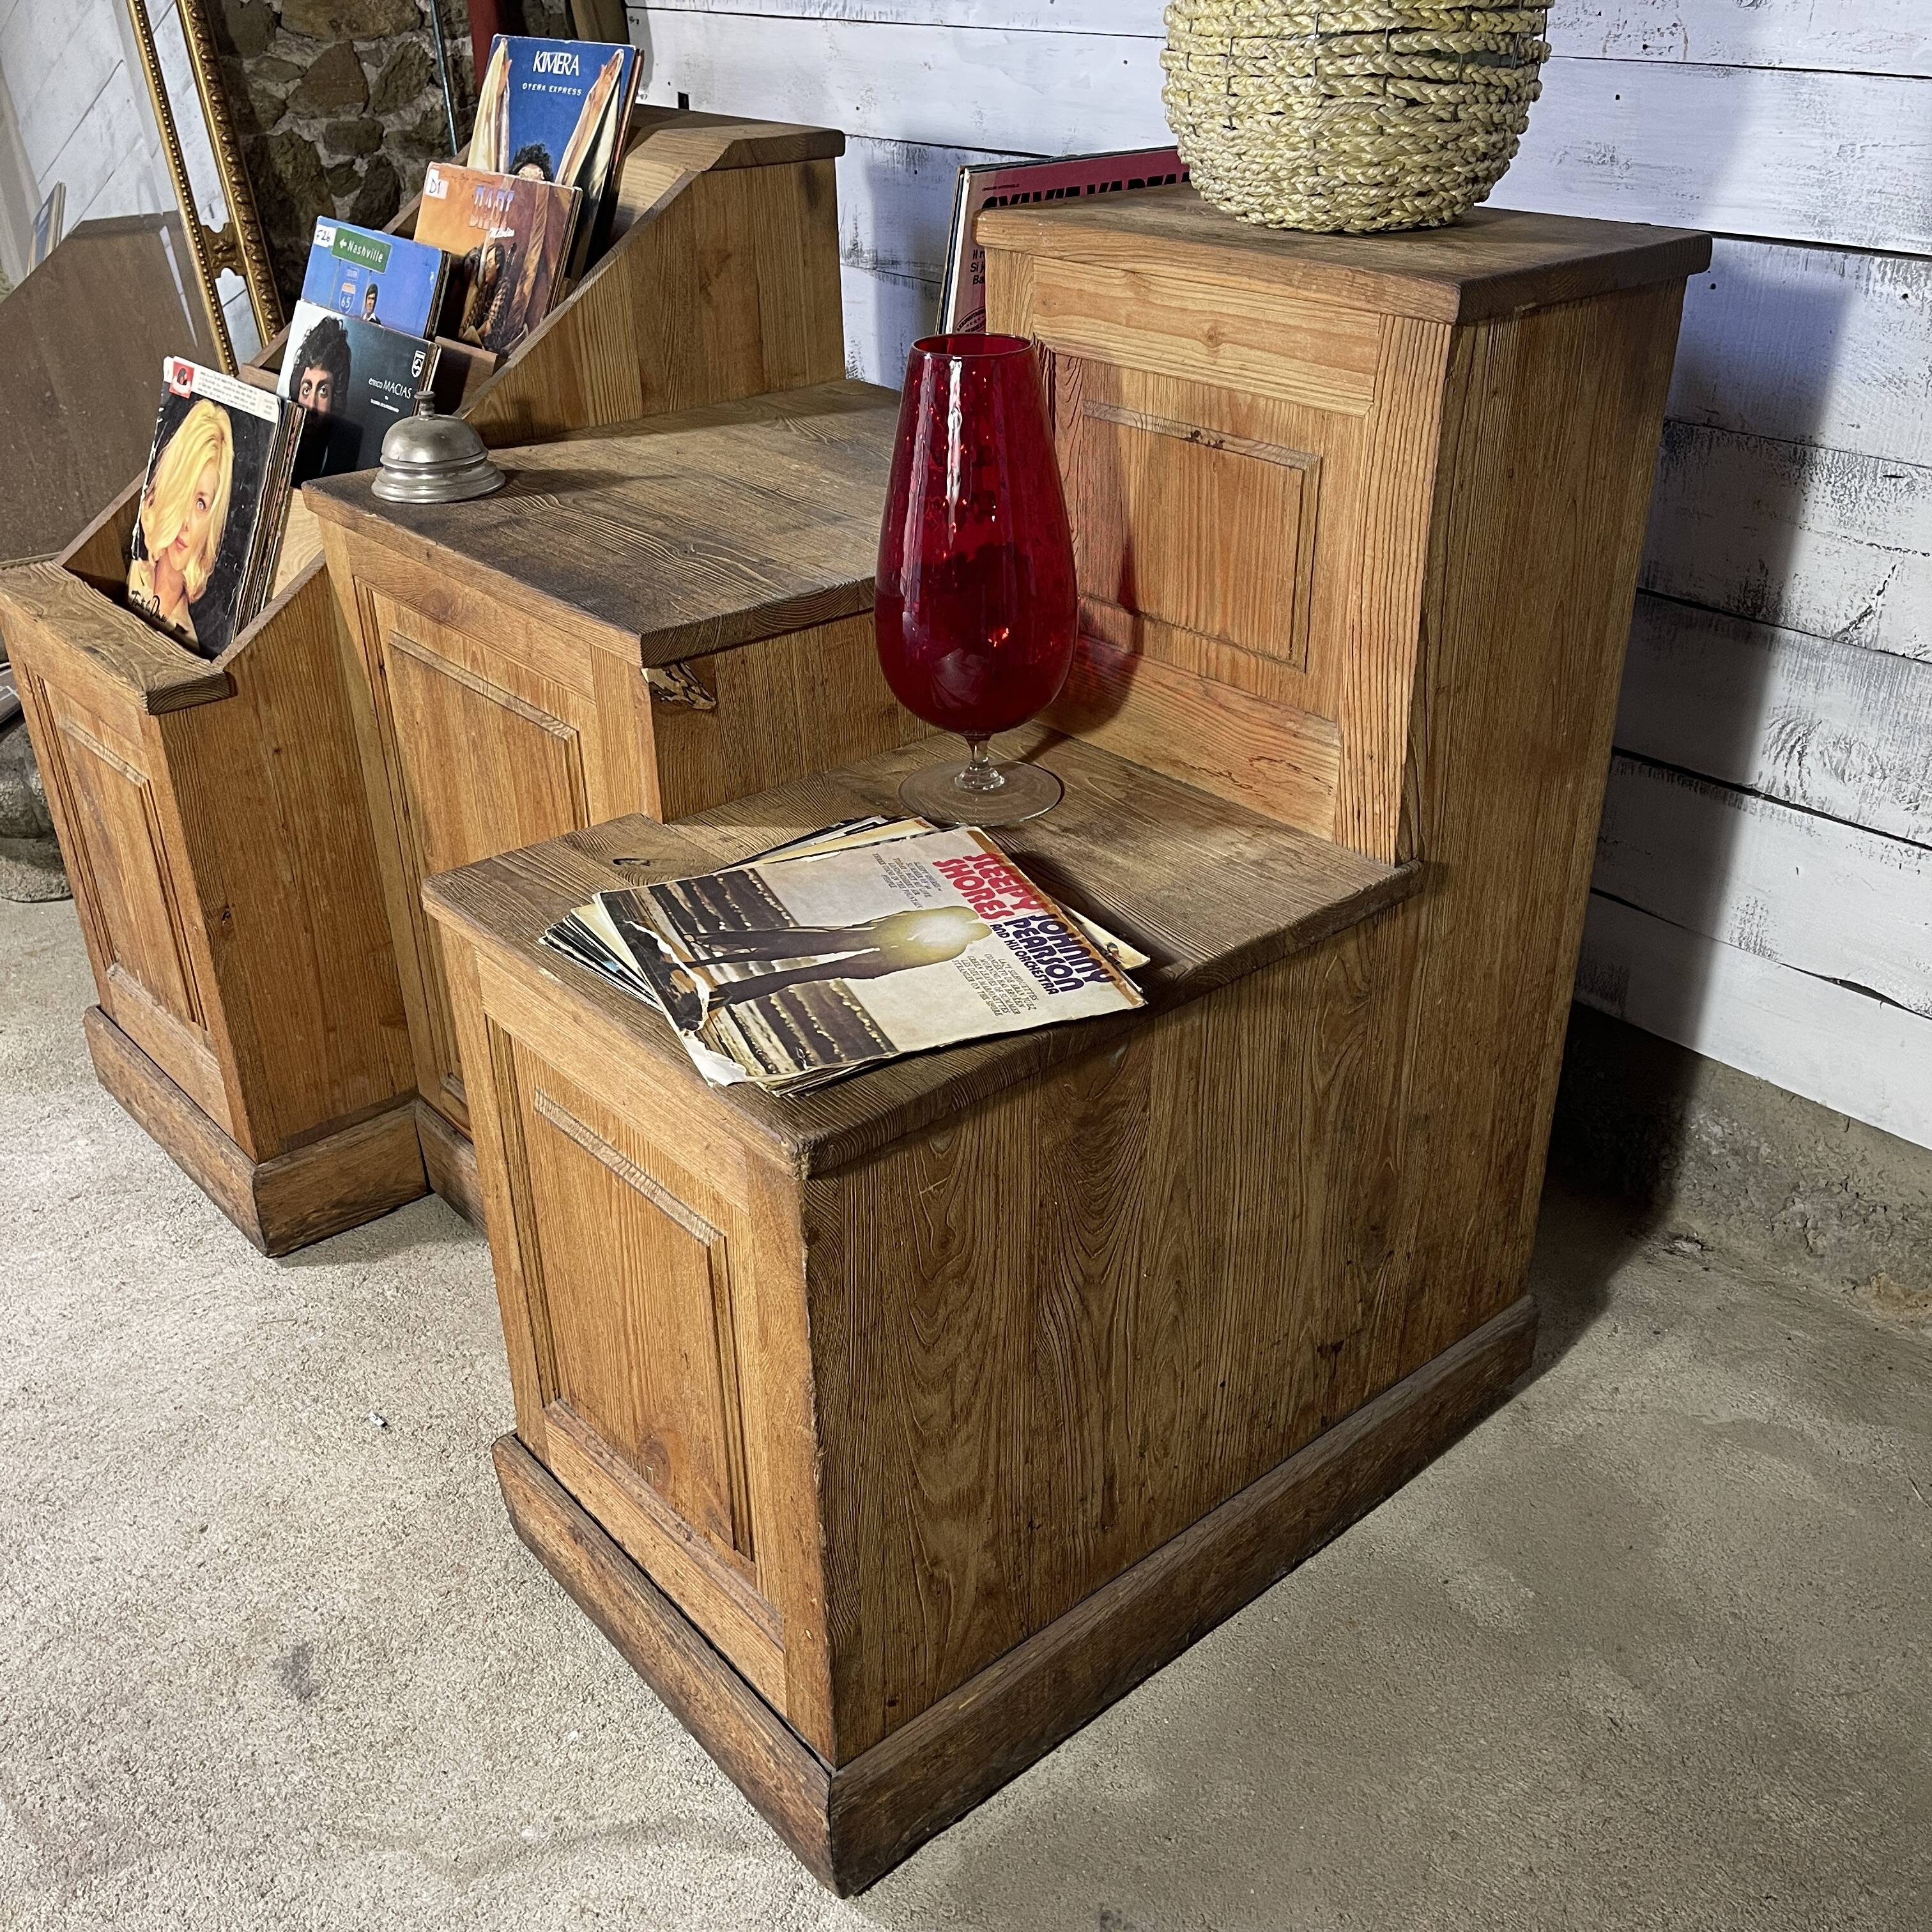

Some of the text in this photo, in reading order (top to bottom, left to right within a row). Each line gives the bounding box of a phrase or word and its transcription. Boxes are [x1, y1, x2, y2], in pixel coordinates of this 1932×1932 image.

[533, 50, 579, 76] KIMERA
[522, 82, 583, 96] OPERA EXPRESS
[347, 240, 383, 263] Nashville
[970, 262, 979, 273] Si
[341, 296, 351, 308] 65
[383, 379, 412, 399] MACIAS
[872, 854, 886, 865] THREE
[882, 866, 895, 876] COINS
[902, 889, 923, 908] FOUNTAIN
[881, 875, 897, 888] PEOPLE
[887, 862, 915, 888] LONDONDERRY
[893, 858, 907, 870] TODAY
[919, 888, 932, 898] LOVE
[906, 863, 923, 878] SUMMER
[914, 861, 940, 887] SLEEPY SHORES
[933, 859, 1015, 919] SHORES
[963, 853, 1046, 910] SLEEPY
[985, 954, 1008, 976] CONCERTO
[990, 924, 1059, 995] AND HIS ORCHESTRA
[1003, 917, 1085, 992] PEARSON
[1029, 914, 1116, 983] JOHNNY
[952, 960, 975, 982] STRANGER
[977, 991, 990, 1000] THE
[985, 1001, 1005, 1016] SHORE
[967, 956, 984, 969] GREEN
[978, 970, 998, 986] LEAVES
[999, 993, 1024, 1015] SUMMER
[967, 968, 984, 980] DEUX
[978, 981, 1011, 1013] MARIONETTES
[979, 959, 1026, 1009] MORNING HAS BROKEN
[998, 959, 1039, 1001] LAZY SILHOUETTES
